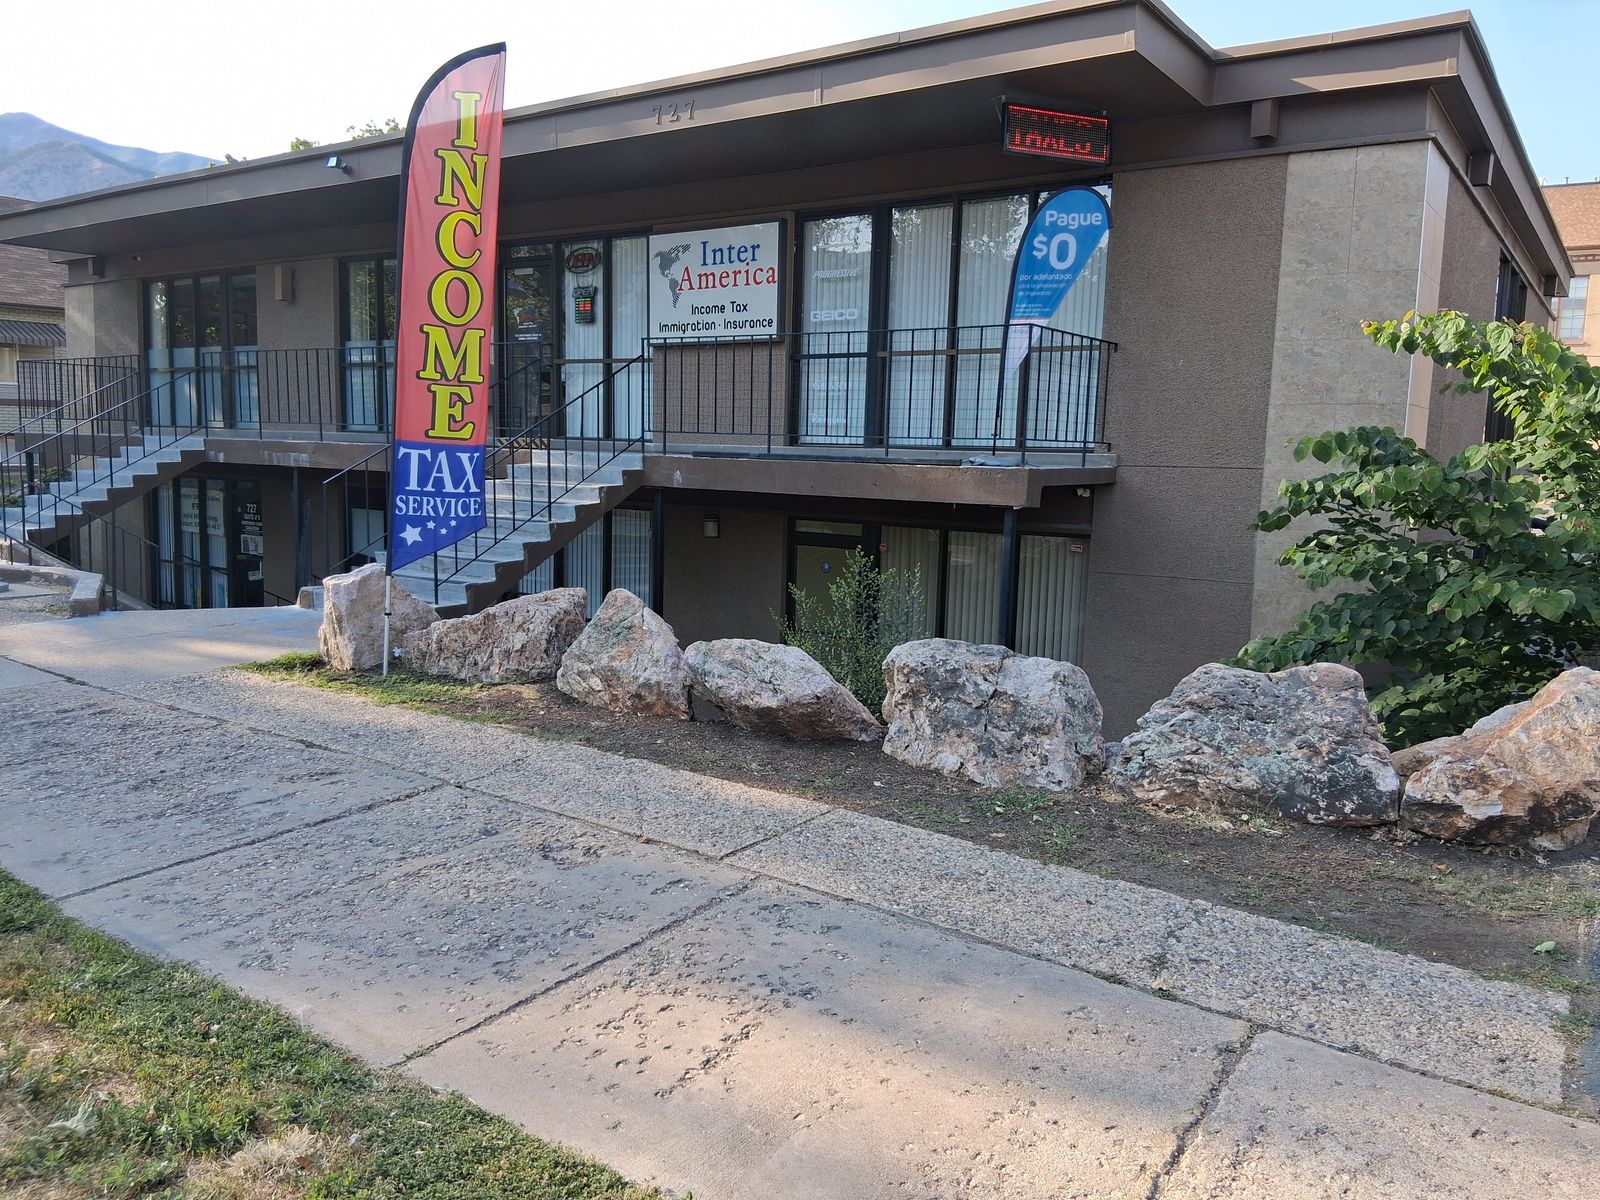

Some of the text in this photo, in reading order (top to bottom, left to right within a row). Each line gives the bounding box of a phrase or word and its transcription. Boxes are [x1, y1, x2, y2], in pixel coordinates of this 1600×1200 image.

[652, 99, 695, 125] 727
[1045, 210, 1102, 229] Pague
[700, 240, 761, 266] Inter
[1032, 232, 1077, 270] $0
[416, 91, 488, 439] INCOME
[813, 268, 860, 279] PROGRESSIVE
[677, 261, 777, 291] America
[1019, 273, 1032, 281] por
[573, 287, 593, 297] OPEN
[691, 301, 748, 315] Income Tax
[810, 308, 857, 322] GEICO
[659, 317, 774, 335] Immigration Insurance
[397, 446, 481, 494] TAX
[246, 503, 257, 513] 727
[395, 494, 482, 517] SERVICE
